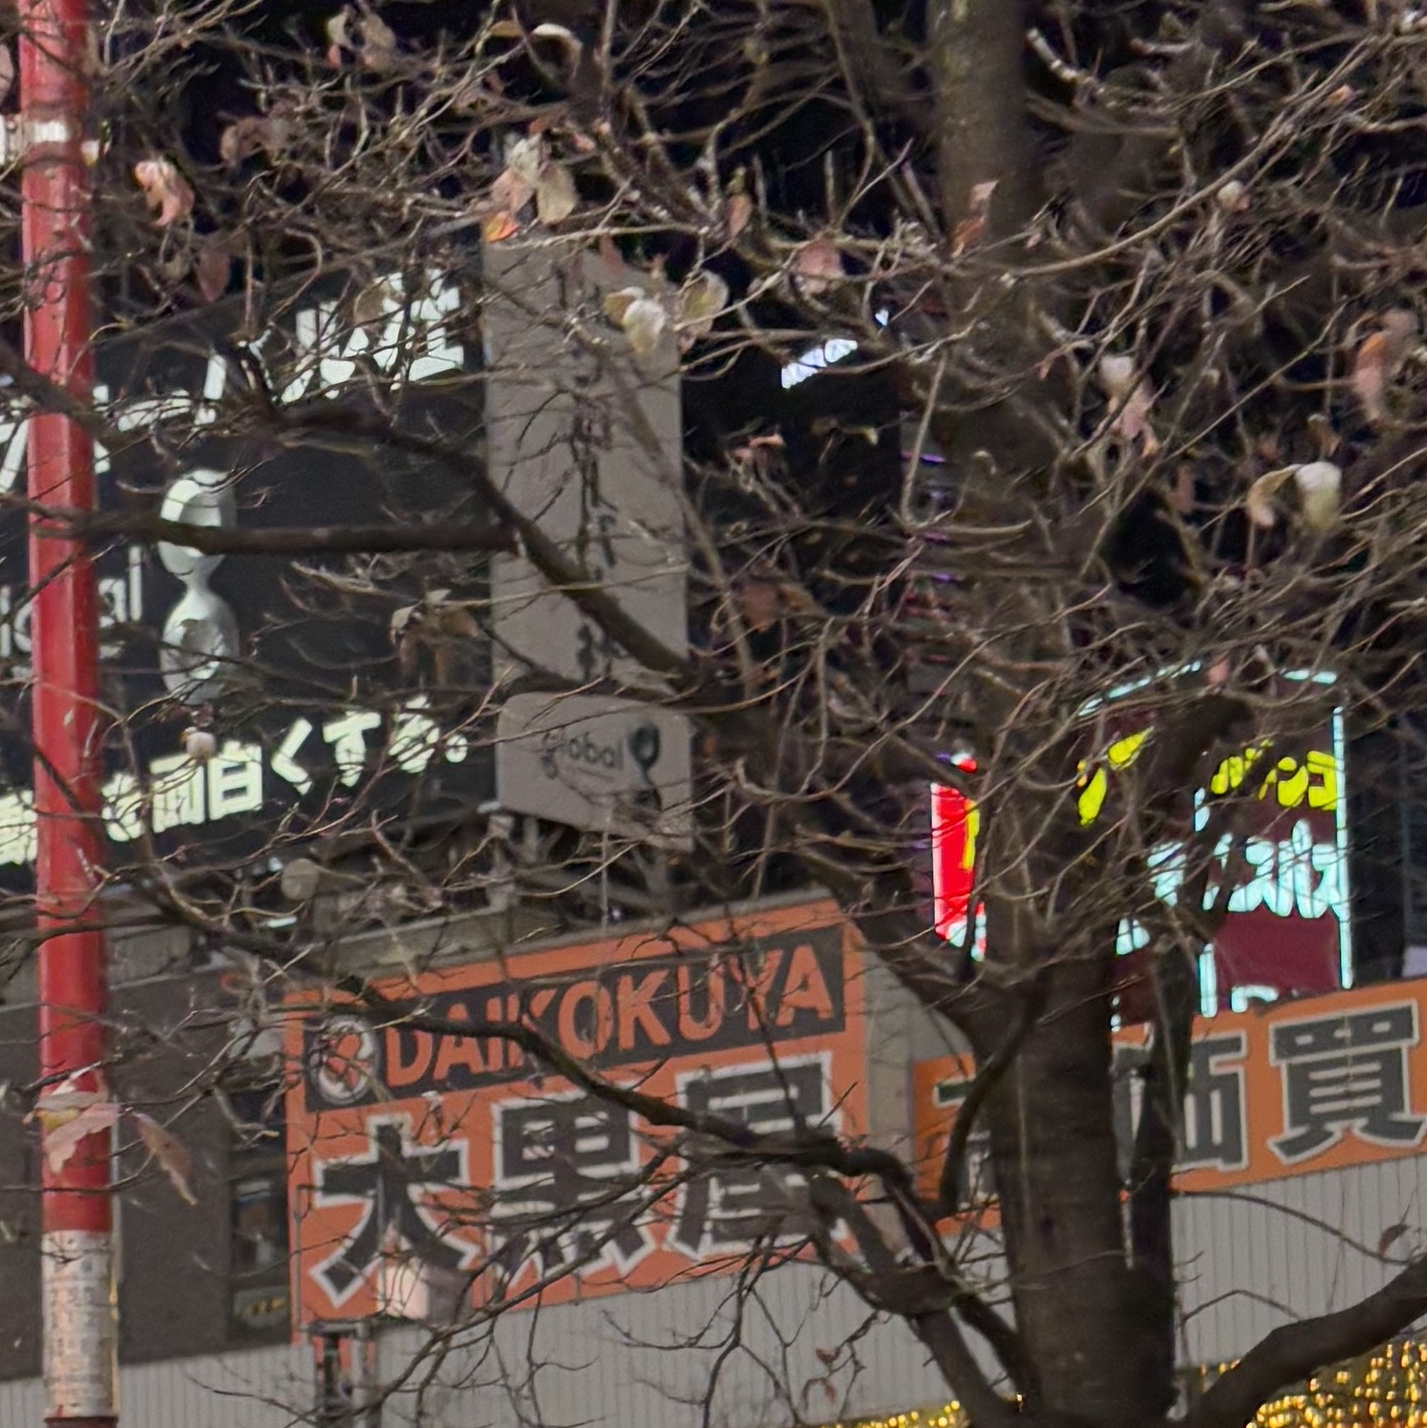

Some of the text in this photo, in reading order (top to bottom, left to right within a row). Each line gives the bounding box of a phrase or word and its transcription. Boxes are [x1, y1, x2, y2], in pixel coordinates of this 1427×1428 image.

[386, 944, 833, 1088] DAIKOKUYA
[312, 1051, 867, 1308] 大黒屋
